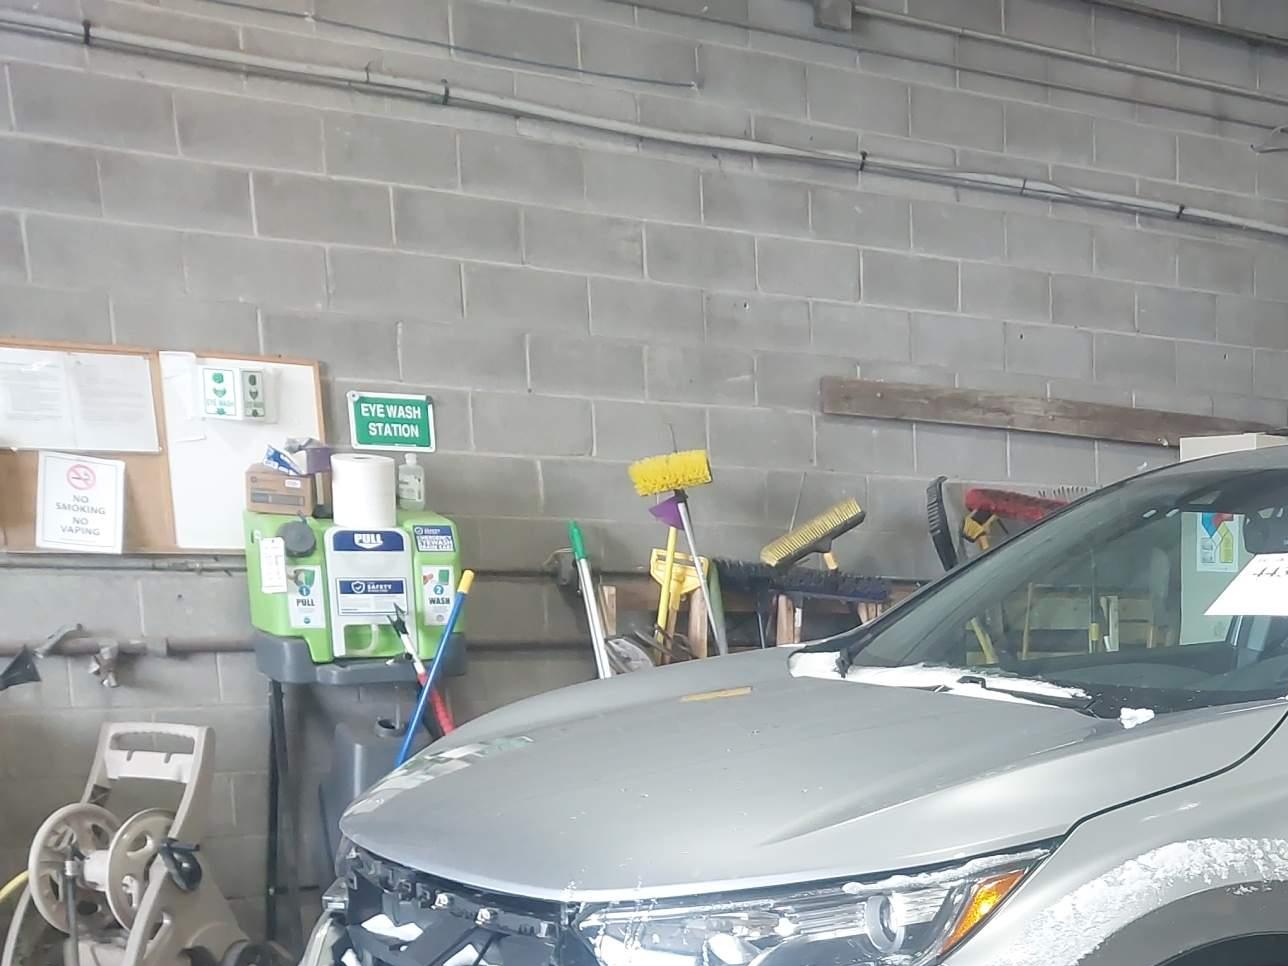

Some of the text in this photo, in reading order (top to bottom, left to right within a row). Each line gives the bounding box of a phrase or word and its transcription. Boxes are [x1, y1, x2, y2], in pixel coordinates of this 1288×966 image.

[360, 403, 421, 419] EYE WASH
[368, 422, 420, 438] STATION
[72, 494, 89, 503] NO
[55, 502, 106, 515] SMOKING
[72, 516, 89, 525] NO
[60, 524, 101, 536] VAPING
[354, 533, 384, 545] PULL
[296, 598, 316, 607] PULL
[428, 597, 450, 605] WASH
